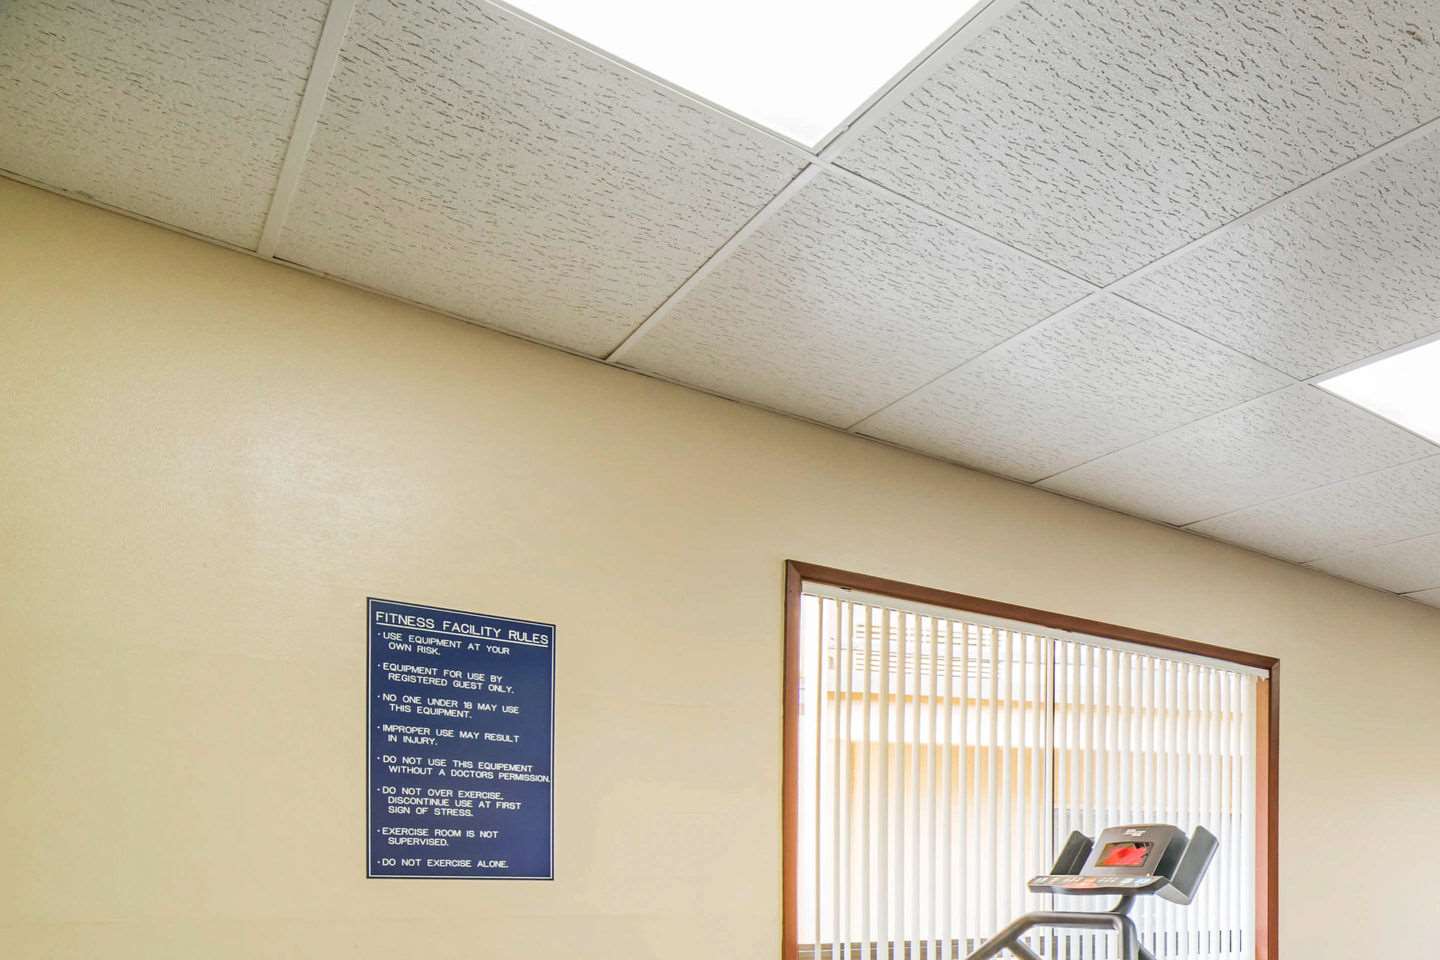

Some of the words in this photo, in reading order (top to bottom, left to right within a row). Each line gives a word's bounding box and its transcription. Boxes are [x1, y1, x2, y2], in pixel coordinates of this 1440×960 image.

[375, 611, 435, 629] FITNESS
[443, 621, 501, 638] FACILITY
[508, 630, 549, 645] RULES
[383, 632, 402, 641] USE
[409, 635, 462, 649] EQUIPMENT
[468, 643, 480, 651] AT
[486, 645, 510, 655] YOUR
[388, 642, 412, 652] OWN
[416, 646, 441, 656] RISK.
[383, 662, 438, 675] EQUIPMENT
[443, 669, 462, 679] FOR
[467, 672, 485, 681] USE
[490, 675, 503, 683] BY
[388, 673, 448, 686] REGISTERED
[453, 680, 483, 690] GUEST
[488, 684, 515, 694] ONLY.
[382, 693, 397, 702] NO
[402, 695, 422, 705] ONE
[427, 698, 458, 708] UNDER
[464, 701, 472, 710] 18
[477, 703, 497, 712] MAY
[502, 705, 520, 714] USE
[389, 703, 411, 713] THIS
[417, 706, 472, 719] EQUIPMENT.
[382, 724, 431, 735] IMPROPER
[436, 729, 454, 738] USE
[459, 731, 479, 740] MAY
[484, 733, 520, 743] RESULT
[383, 755, 397, 764] DO
[402, 756, 422, 765] NOT
[427, 758, 447, 767] USE
[452, 760, 473, 769] THIS
[388, 766, 433, 775] WITHOUT
[438, 768, 446, 776] A
[451, 769, 494, 779] DOCTORS
[382, 786, 396, 795] DO
[402, 787, 421, 796] NOT
[427, 789, 453, 798] OVER
[388, 796, 449, 807] DISCONTINUE
[455, 799, 473, 808] USE
[496, 801, 522, 810] FIRST
[388, 805, 411, 814] SIGN
[416, 807, 428, 815] OF
[434, 808, 474, 817] STRESS.
[382, 827, 429, 836] EXERCISE
[435, 829, 462, 838] ROOM
[466, 830, 475, 838] IS
[480, 830, 499, 839] NOT
[388, 837, 449, 846] SUPERVISED.
[382, 858, 396, 866] DO
[401, 858, 421, 867] NOT
[427, 859, 472, 868] EXERCISE
[477, 860, 509, 868] ALONE.
